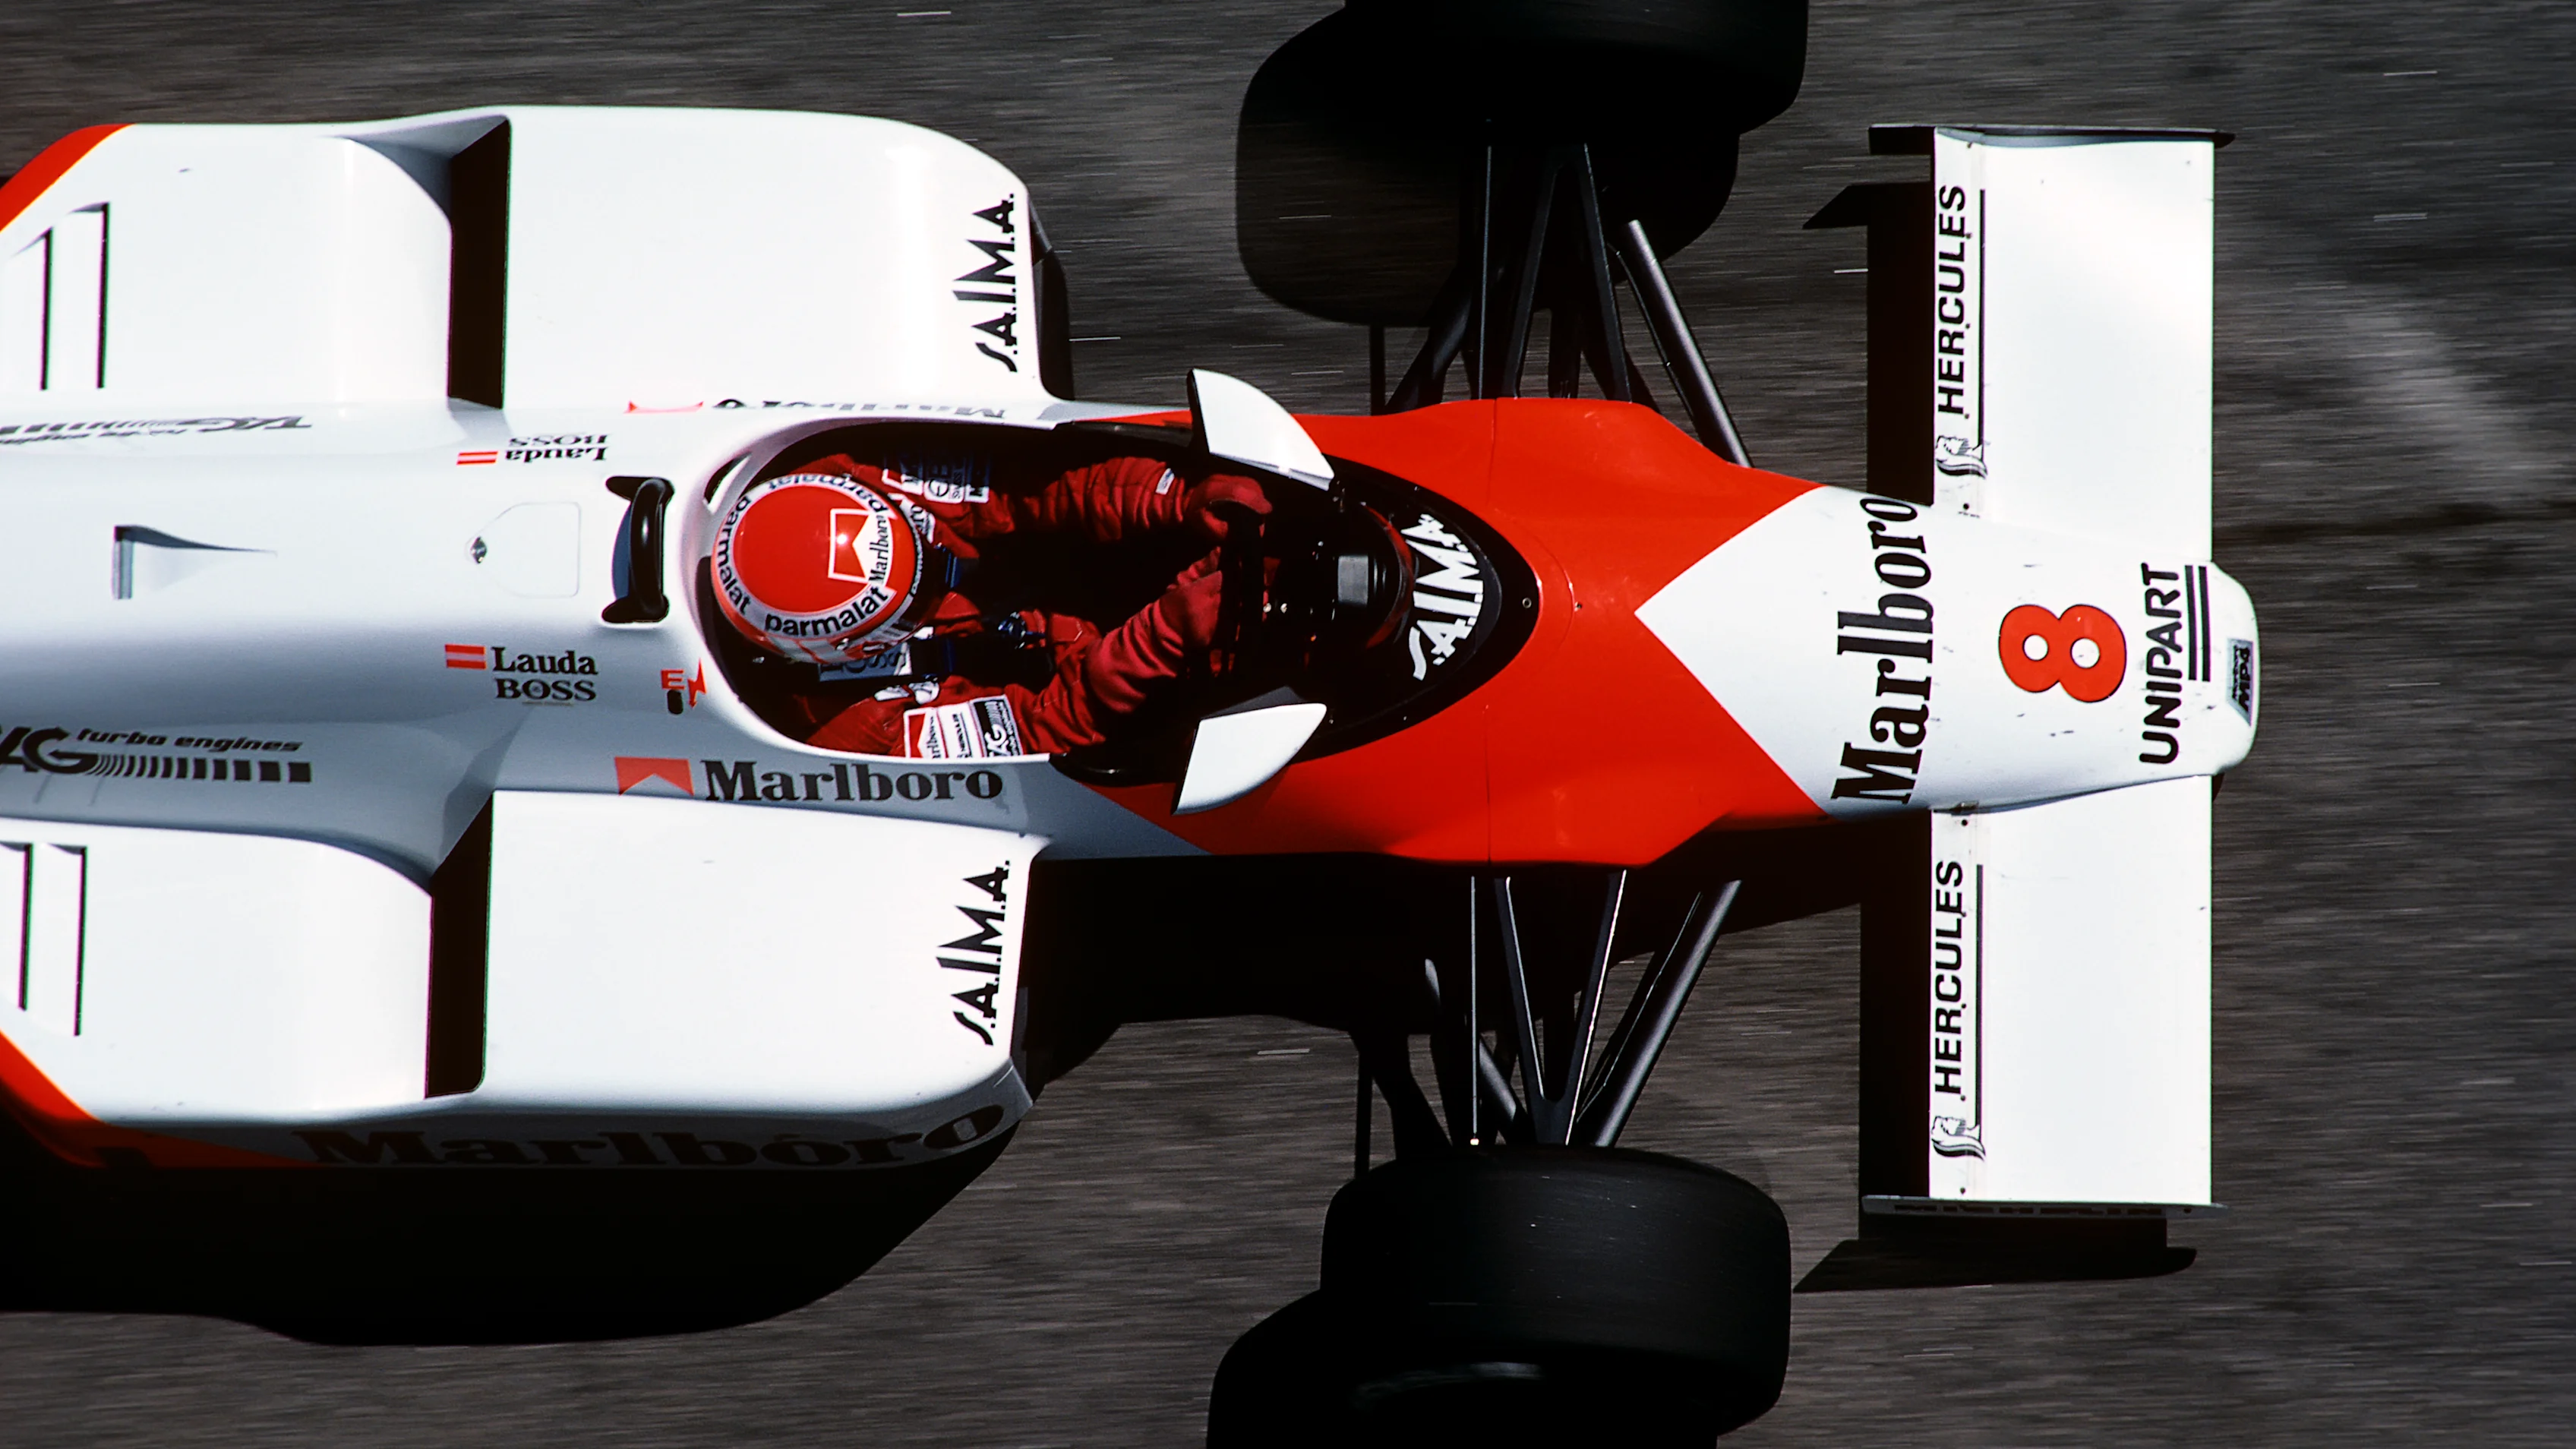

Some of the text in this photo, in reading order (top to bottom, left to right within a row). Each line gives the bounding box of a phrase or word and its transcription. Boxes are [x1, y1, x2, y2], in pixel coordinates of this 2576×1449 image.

[1938, 185, 1965, 415] HERCULES
[505, 447, 608, 463] Lauda
[510, 434, 608, 446] BOSS
[768, 473, 889, 513] parmalat
[718, 495, 751, 614] parmalat
[765, 586, 889, 636] parmalat
[491, 646, 598, 675] Lauda
[1830, 497, 1934, 803] Marlboro
[1998, 604, 2126, 702] 8
[2139, 562, 2183, 764] UNIPART
[494, 678, 596, 701] BOSS
[661, 669, 685, 690] E
[0, 727, 303, 775] AG turbo engines
[702, 760, 1002, 801] Marlboro
[1935, 860, 1963, 1094] HERCULES
[292, 1104, 1004, 1167] Marlboro
